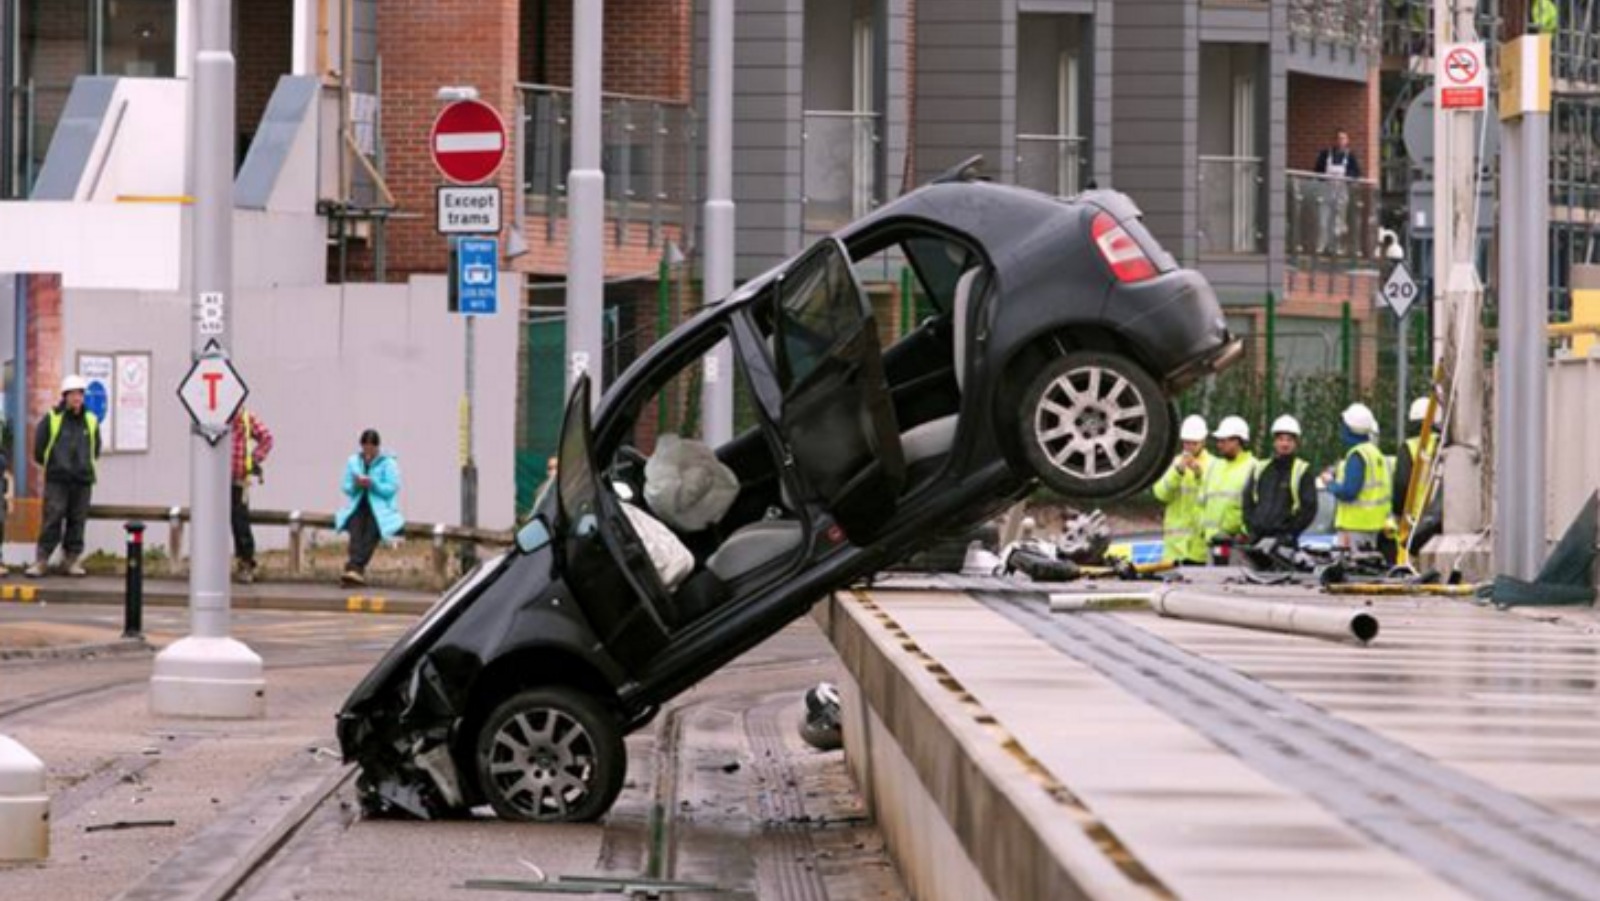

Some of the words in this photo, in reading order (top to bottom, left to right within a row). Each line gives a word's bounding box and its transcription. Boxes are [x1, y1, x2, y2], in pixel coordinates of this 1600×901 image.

[445, 194, 494, 209] Except
[448, 211, 490, 225] trams
[1388, 282, 1413, 298] 20
[202, 373, 223, 410] T
